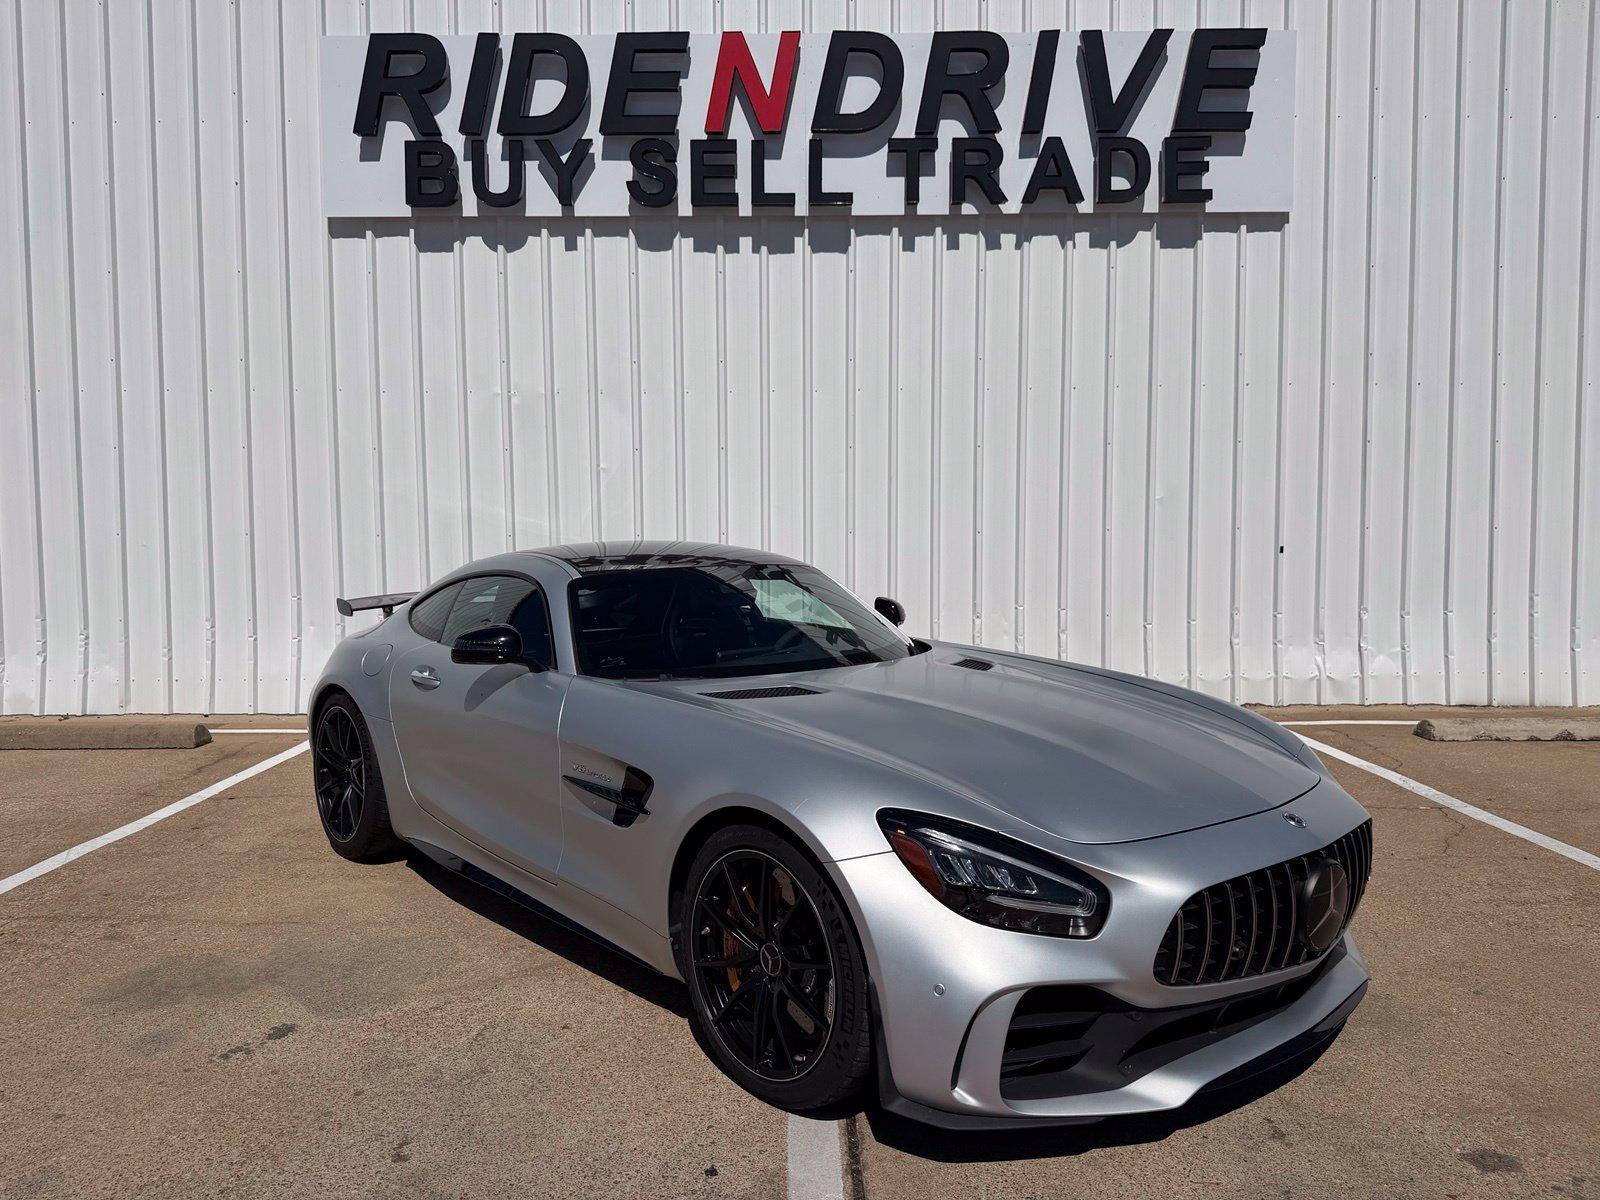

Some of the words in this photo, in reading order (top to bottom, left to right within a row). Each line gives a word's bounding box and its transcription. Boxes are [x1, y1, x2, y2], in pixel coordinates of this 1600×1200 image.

[353, 28, 1267, 136] RIDENDRIVE
[404, 138, 593, 208] BUY
[626, 137, 853, 208] SELL
[887, 136, 1213, 206] TRADE
